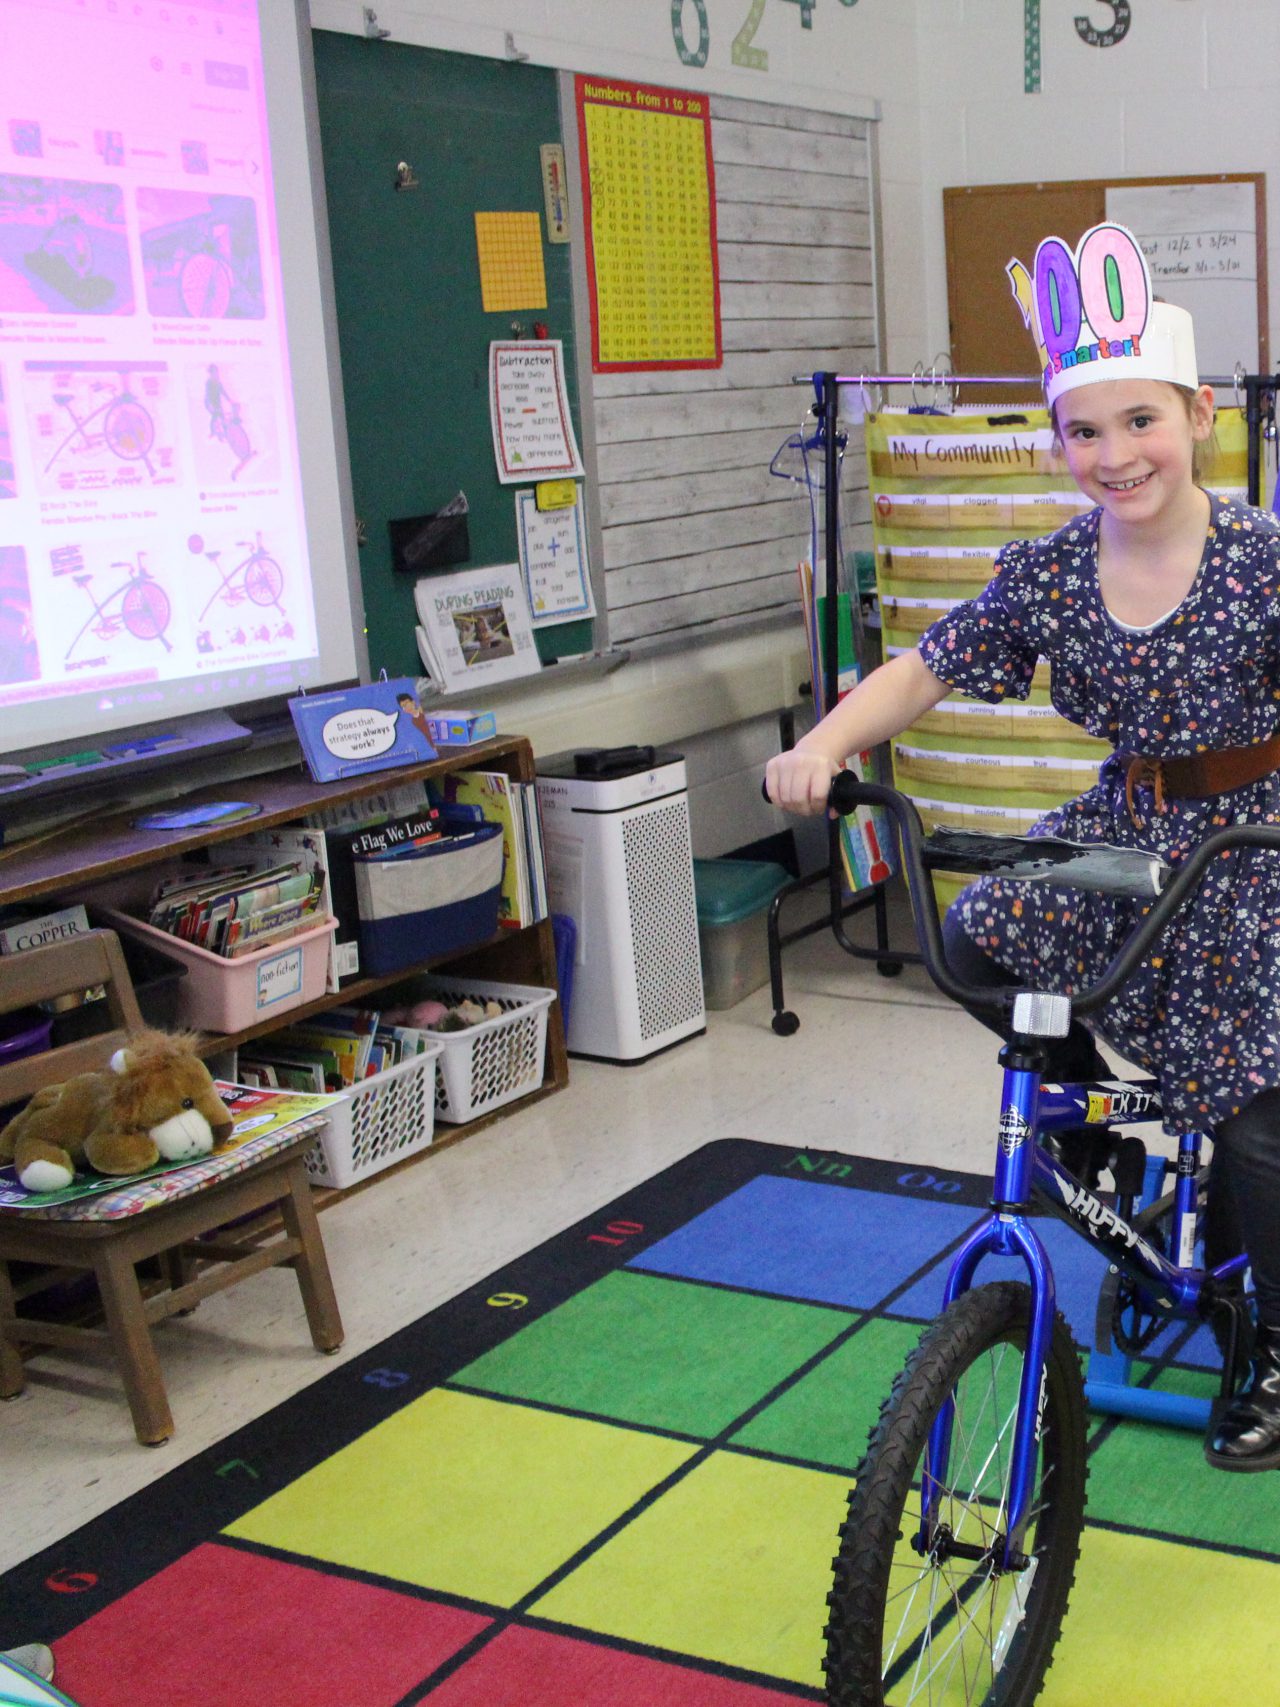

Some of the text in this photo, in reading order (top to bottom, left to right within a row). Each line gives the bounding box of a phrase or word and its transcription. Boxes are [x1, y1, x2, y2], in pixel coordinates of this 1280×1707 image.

[584, 83, 632, 103] Numbers
[636, 90, 661, 108] from
[673, 98, 684, 111] to
[687, 99, 702, 113] 200
[499, 355, 552, 367] Subtraction
[1053, 334, 1141, 374] smarter!
[893, 436, 1036, 471] My Community
[963, 497, 998, 506] clogged
[1033, 497, 1057, 505] waste
[962, 550, 991, 558] flexible
[435, 592, 473, 612] DURING
[473, 585, 514, 602] READING
[968, 706, 996, 716] running
[328, 725, 391, 745] strategy always
[336, 717, 374, 732] Does that
[350, 739, 376, 751] work?
[965, 757, 1001, 766] courteous
[974, 808, 1006, 818] insulated
[360, 820, 433, 851] Flag We Love
[16, 921, 80, 951] COPPER
[260, 961, 299, 985] non-fiction
[1132, 1093, 1153, 1113] IT
[784, 1154, 853, 1178] Nn
[897, 1171, 961, 1193] Oo
[1070, 1187, 1139, 1248] HUFFY
